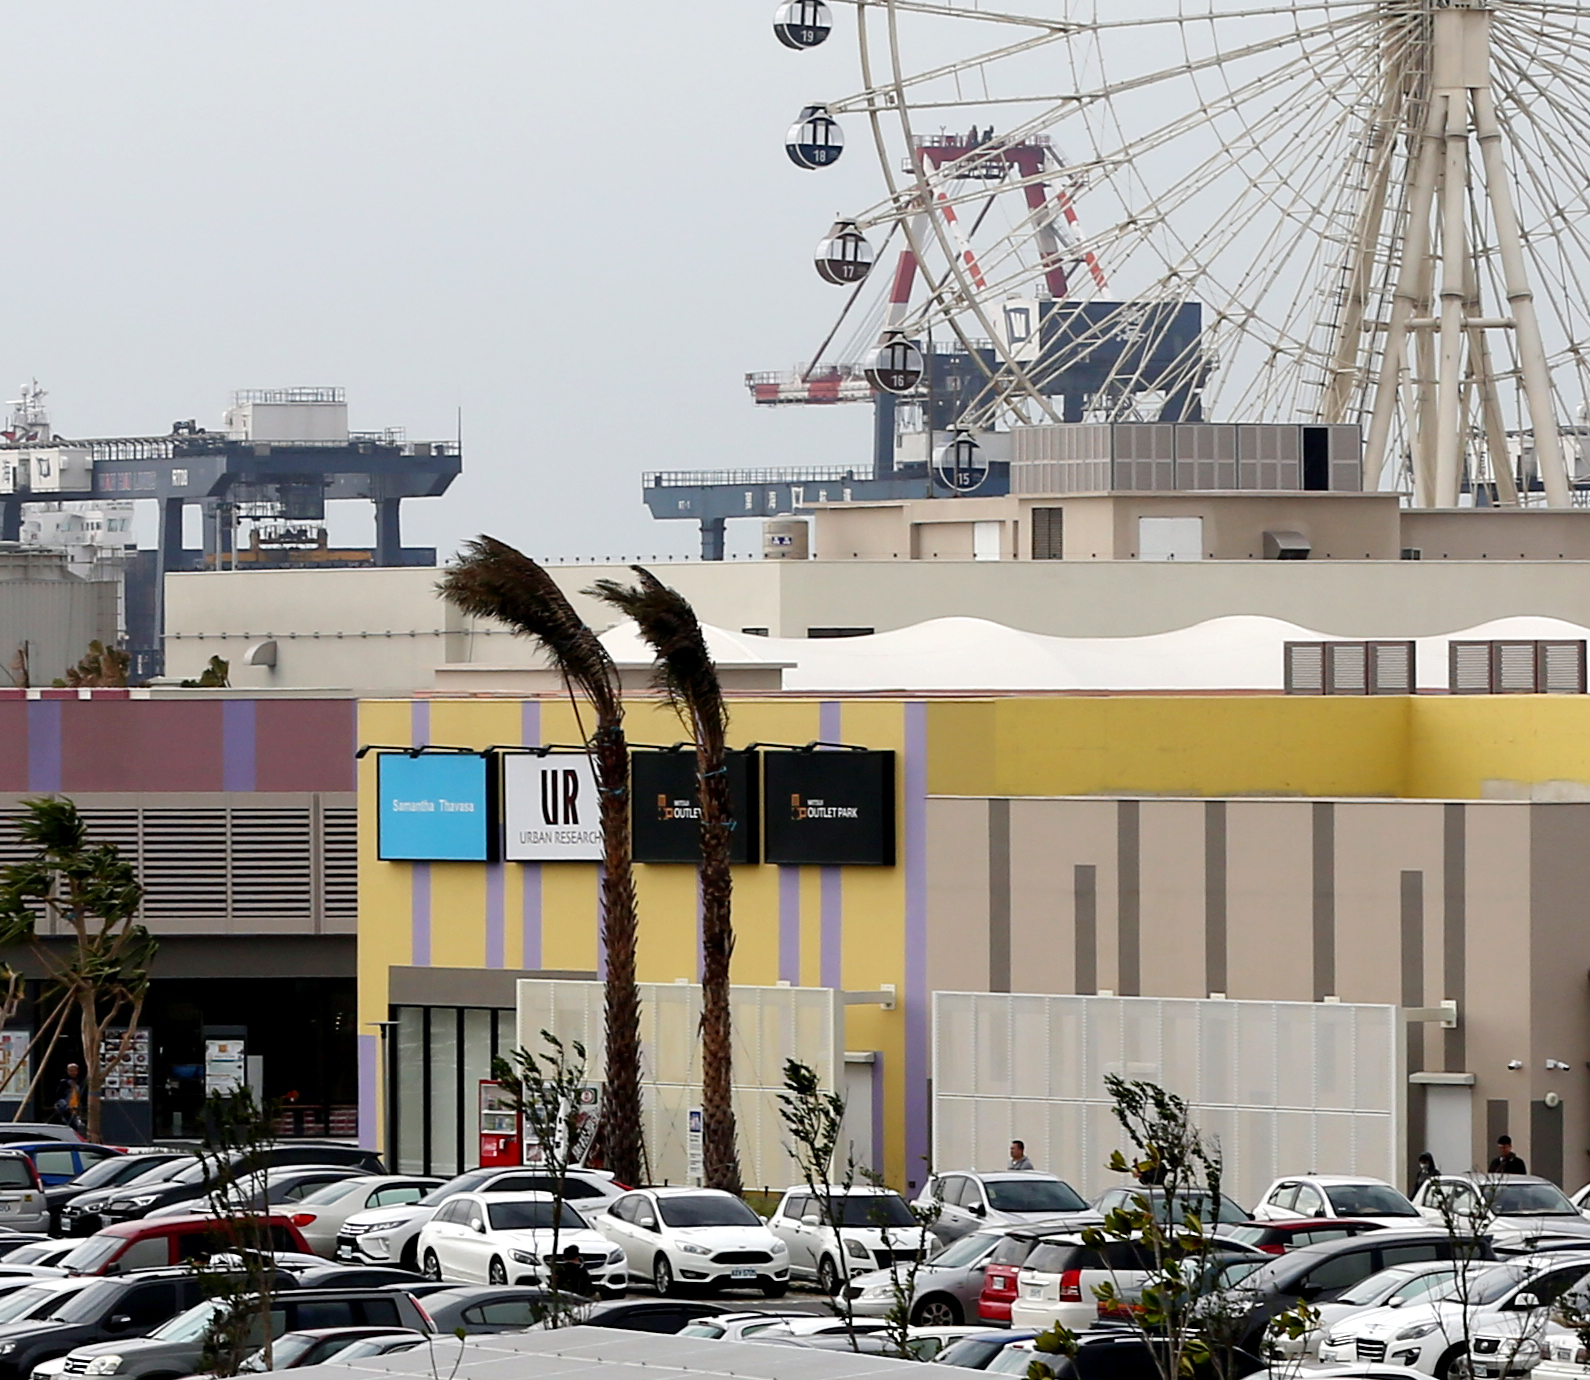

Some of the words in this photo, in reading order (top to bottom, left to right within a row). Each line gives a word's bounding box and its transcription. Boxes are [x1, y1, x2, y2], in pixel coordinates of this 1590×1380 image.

[803, 30, 813, 42] 19
[814, 150, 826, 162] 18
[843, 265, 854, 277] 17
[892, 375, 904, 387] 16
[959, 473, 969, 485] 15
[541, 770, 579, 825] UR
[392, 799, 435, 812] Samantha
[439, 799, 474, 812] Thavasa
[807, 807, 837, 818] OUTLET
[838, 807, 858, 818] PARK
[520, 831, 552, 844] URBAN
[555, 831, 600, 844] RESEARCH
